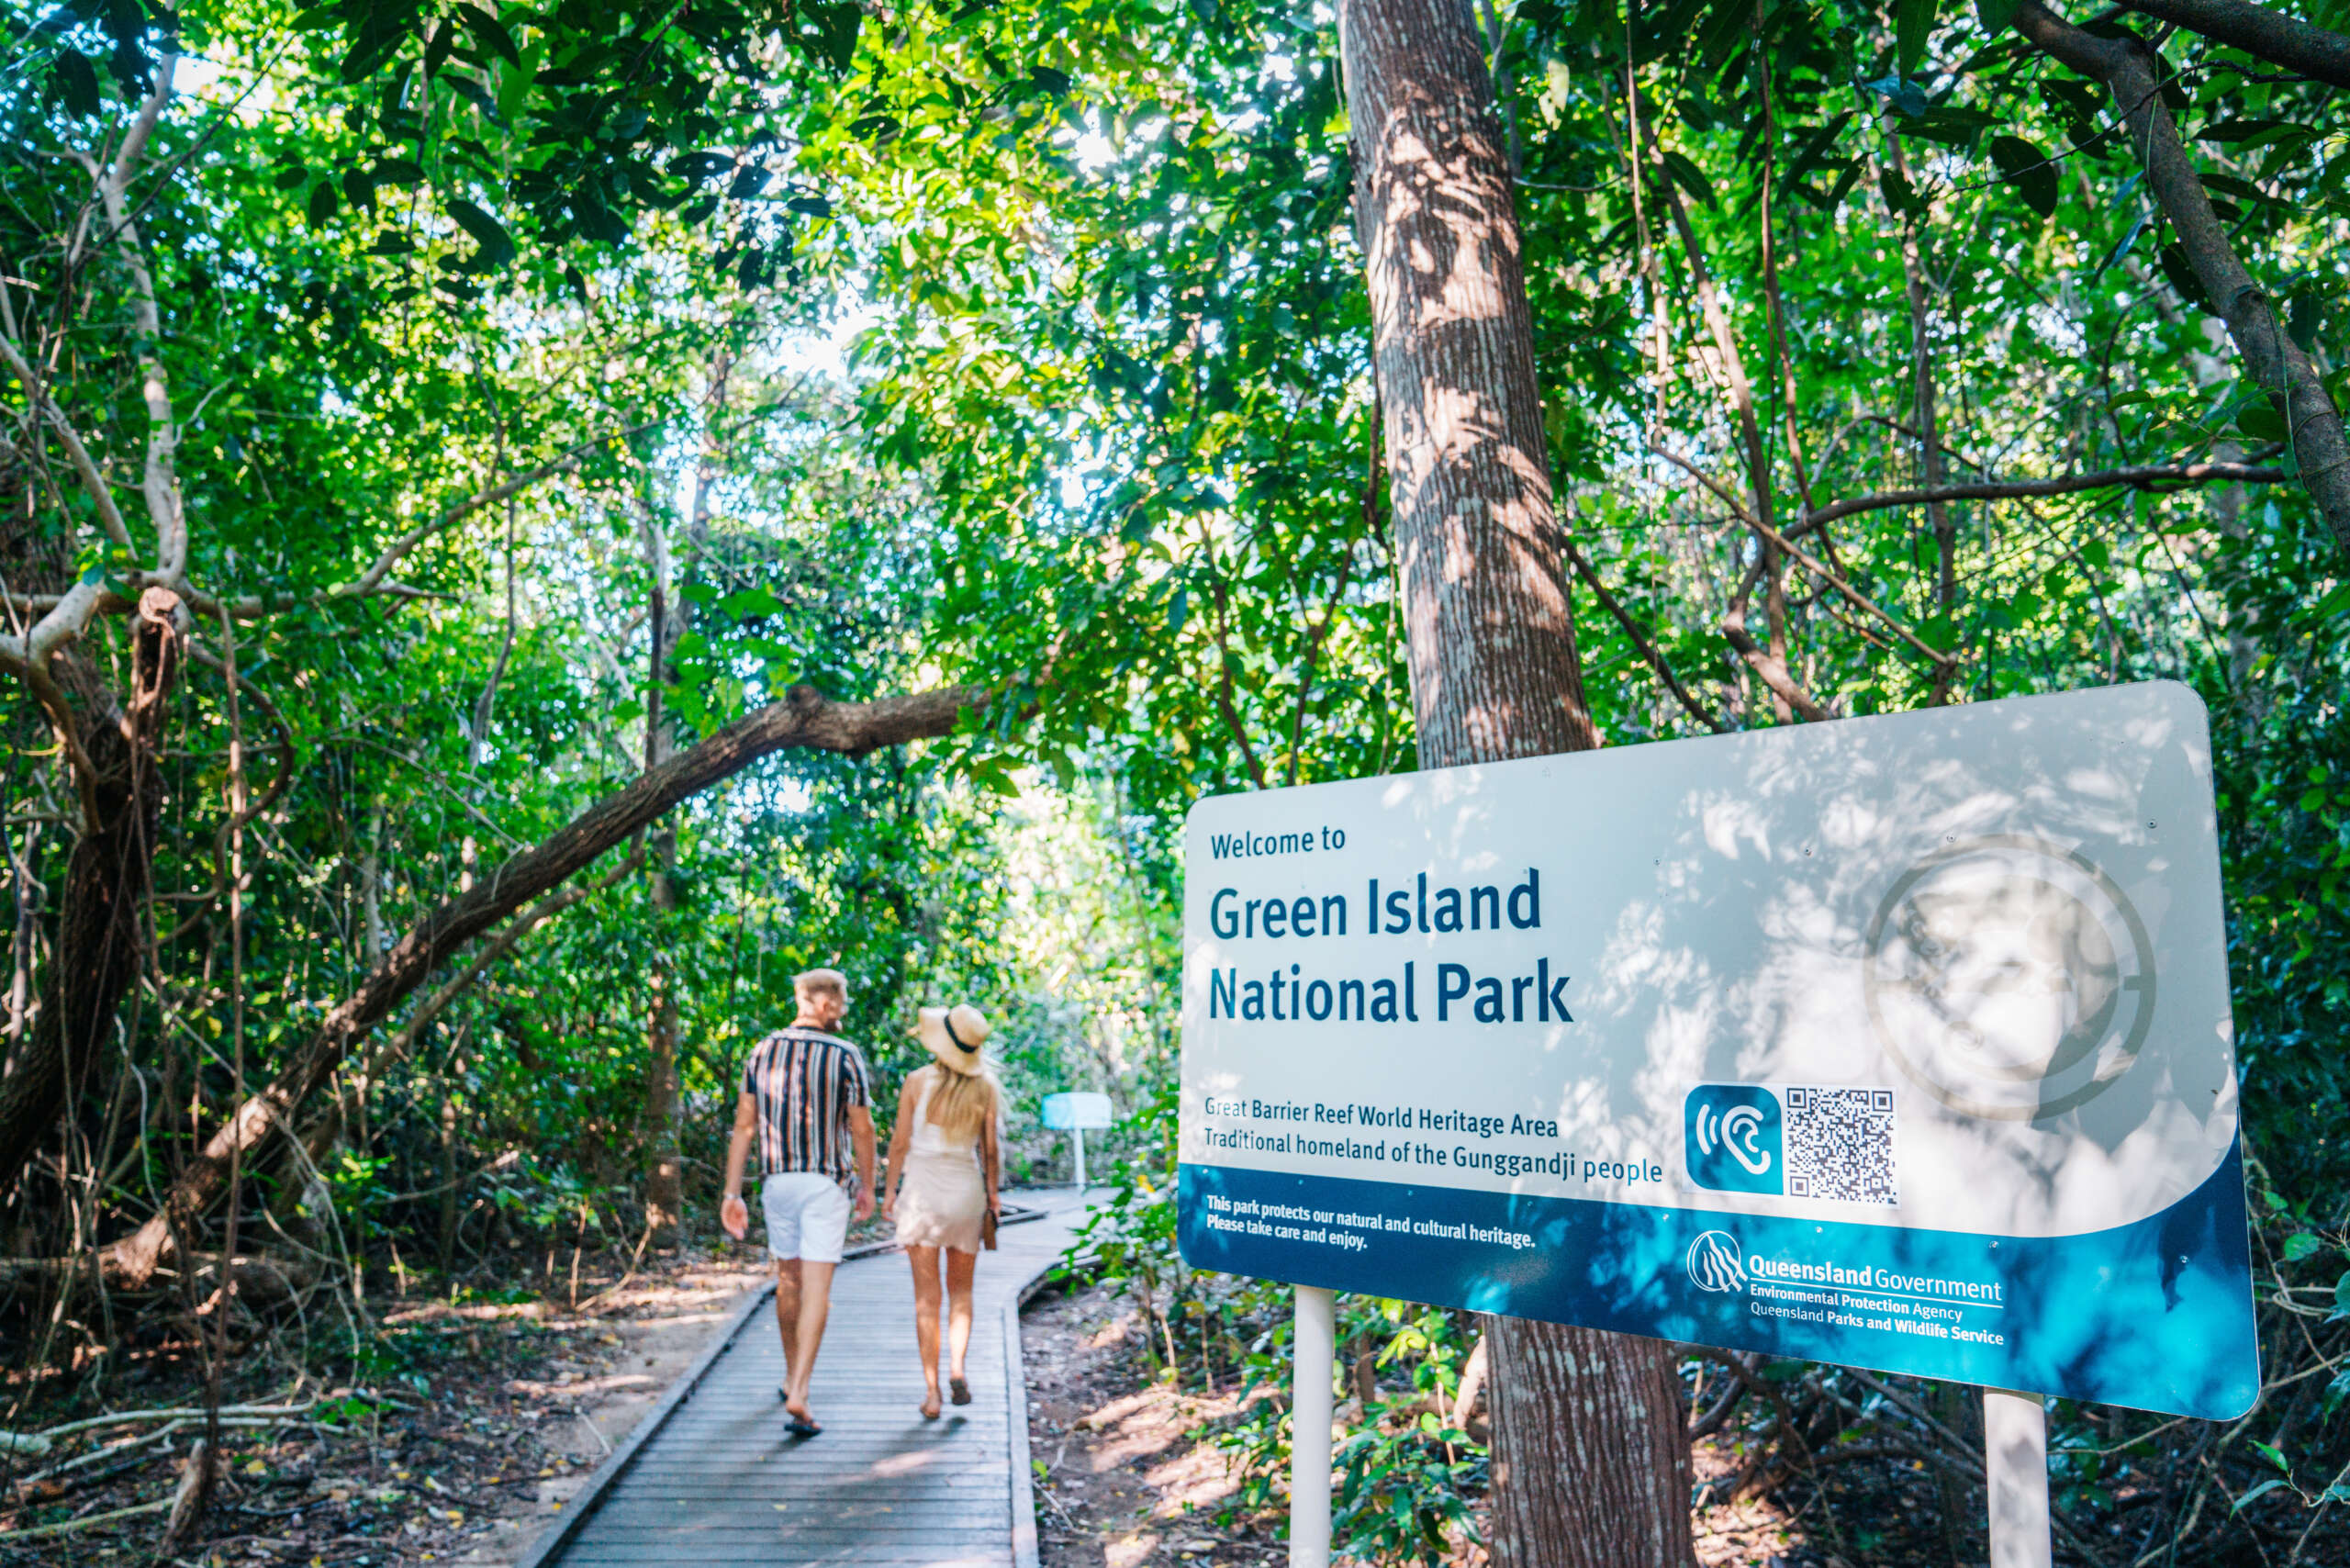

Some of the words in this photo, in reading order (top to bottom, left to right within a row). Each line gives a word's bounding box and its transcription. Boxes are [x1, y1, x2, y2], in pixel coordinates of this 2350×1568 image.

[1212, 831, 1314, 859] Welcome
[1323, 825, 1346, 850] to
[1211, 888, 1348, 939] Green
[1369, 867, 1540, 935] Island
[1210, 961, 1418, 1024] National
[1438, 957, 1574, 1024] Park
[1204, 1097, 1248, 1118] Great
[1252, 1100, 1309, 1122] Barrier
[1315, 1103, 1353, 1126] Reef
[1359, 1105, 1413, 1128] World
[1419, 1108, 1505, 1137] Heritage
[1511, 1114, 1558, 1137] Area
[1204, 1127, 1291, 1154] Traditional
[1297, 1134, 1385, 1161] homeland
[1392, 1140, 1411, 1163] of
[1415, 1142, 1447, 1167] the
[1453, 1146, 1575, 1182] Gunggandji
[1583, 1158, 1662, 1185] people
[1207, 1195, 1230, 1212] This
[1234, 1198, 1259, 1217] park
[1262, 1202, 1310, 1222] protects
[1313, 1210, 1334, 1225] our
[1337, 1211, 1382, 1230] natural
[1385, 1215, 1410, 1234] and
[1414, 1218, 1466, 1239] cultural
[1470, 1224, 1535, 1249] heritage.
[1207, 1215, 1244, 1232] Please
[1247, 1219, 1271, 1237] take
[1275, 1224, 1300, 1239] care
[1303, 1225, 1326, 1243] and
[1329, 1230, 1368, 1251] enjoy.
[1750, 1254, 1872, 1286] Queensland
[1874, 1268, 2002, 1301] Government
[1751, 1283, 1839, 1305] Environmental
[1841, 1293, 1909, 1315] Protection
[1913, 1301, 1962, 1321] Agency
[1751, 1301, 1824, 1323] Queensland
[1828, 1310, 1863, 1328] Parks
[1866, 1314, 1892, 1331] and
[1895, 1317, 1948, 1338] Wildlife
[1952, 1325, 2003, 1345] Service
